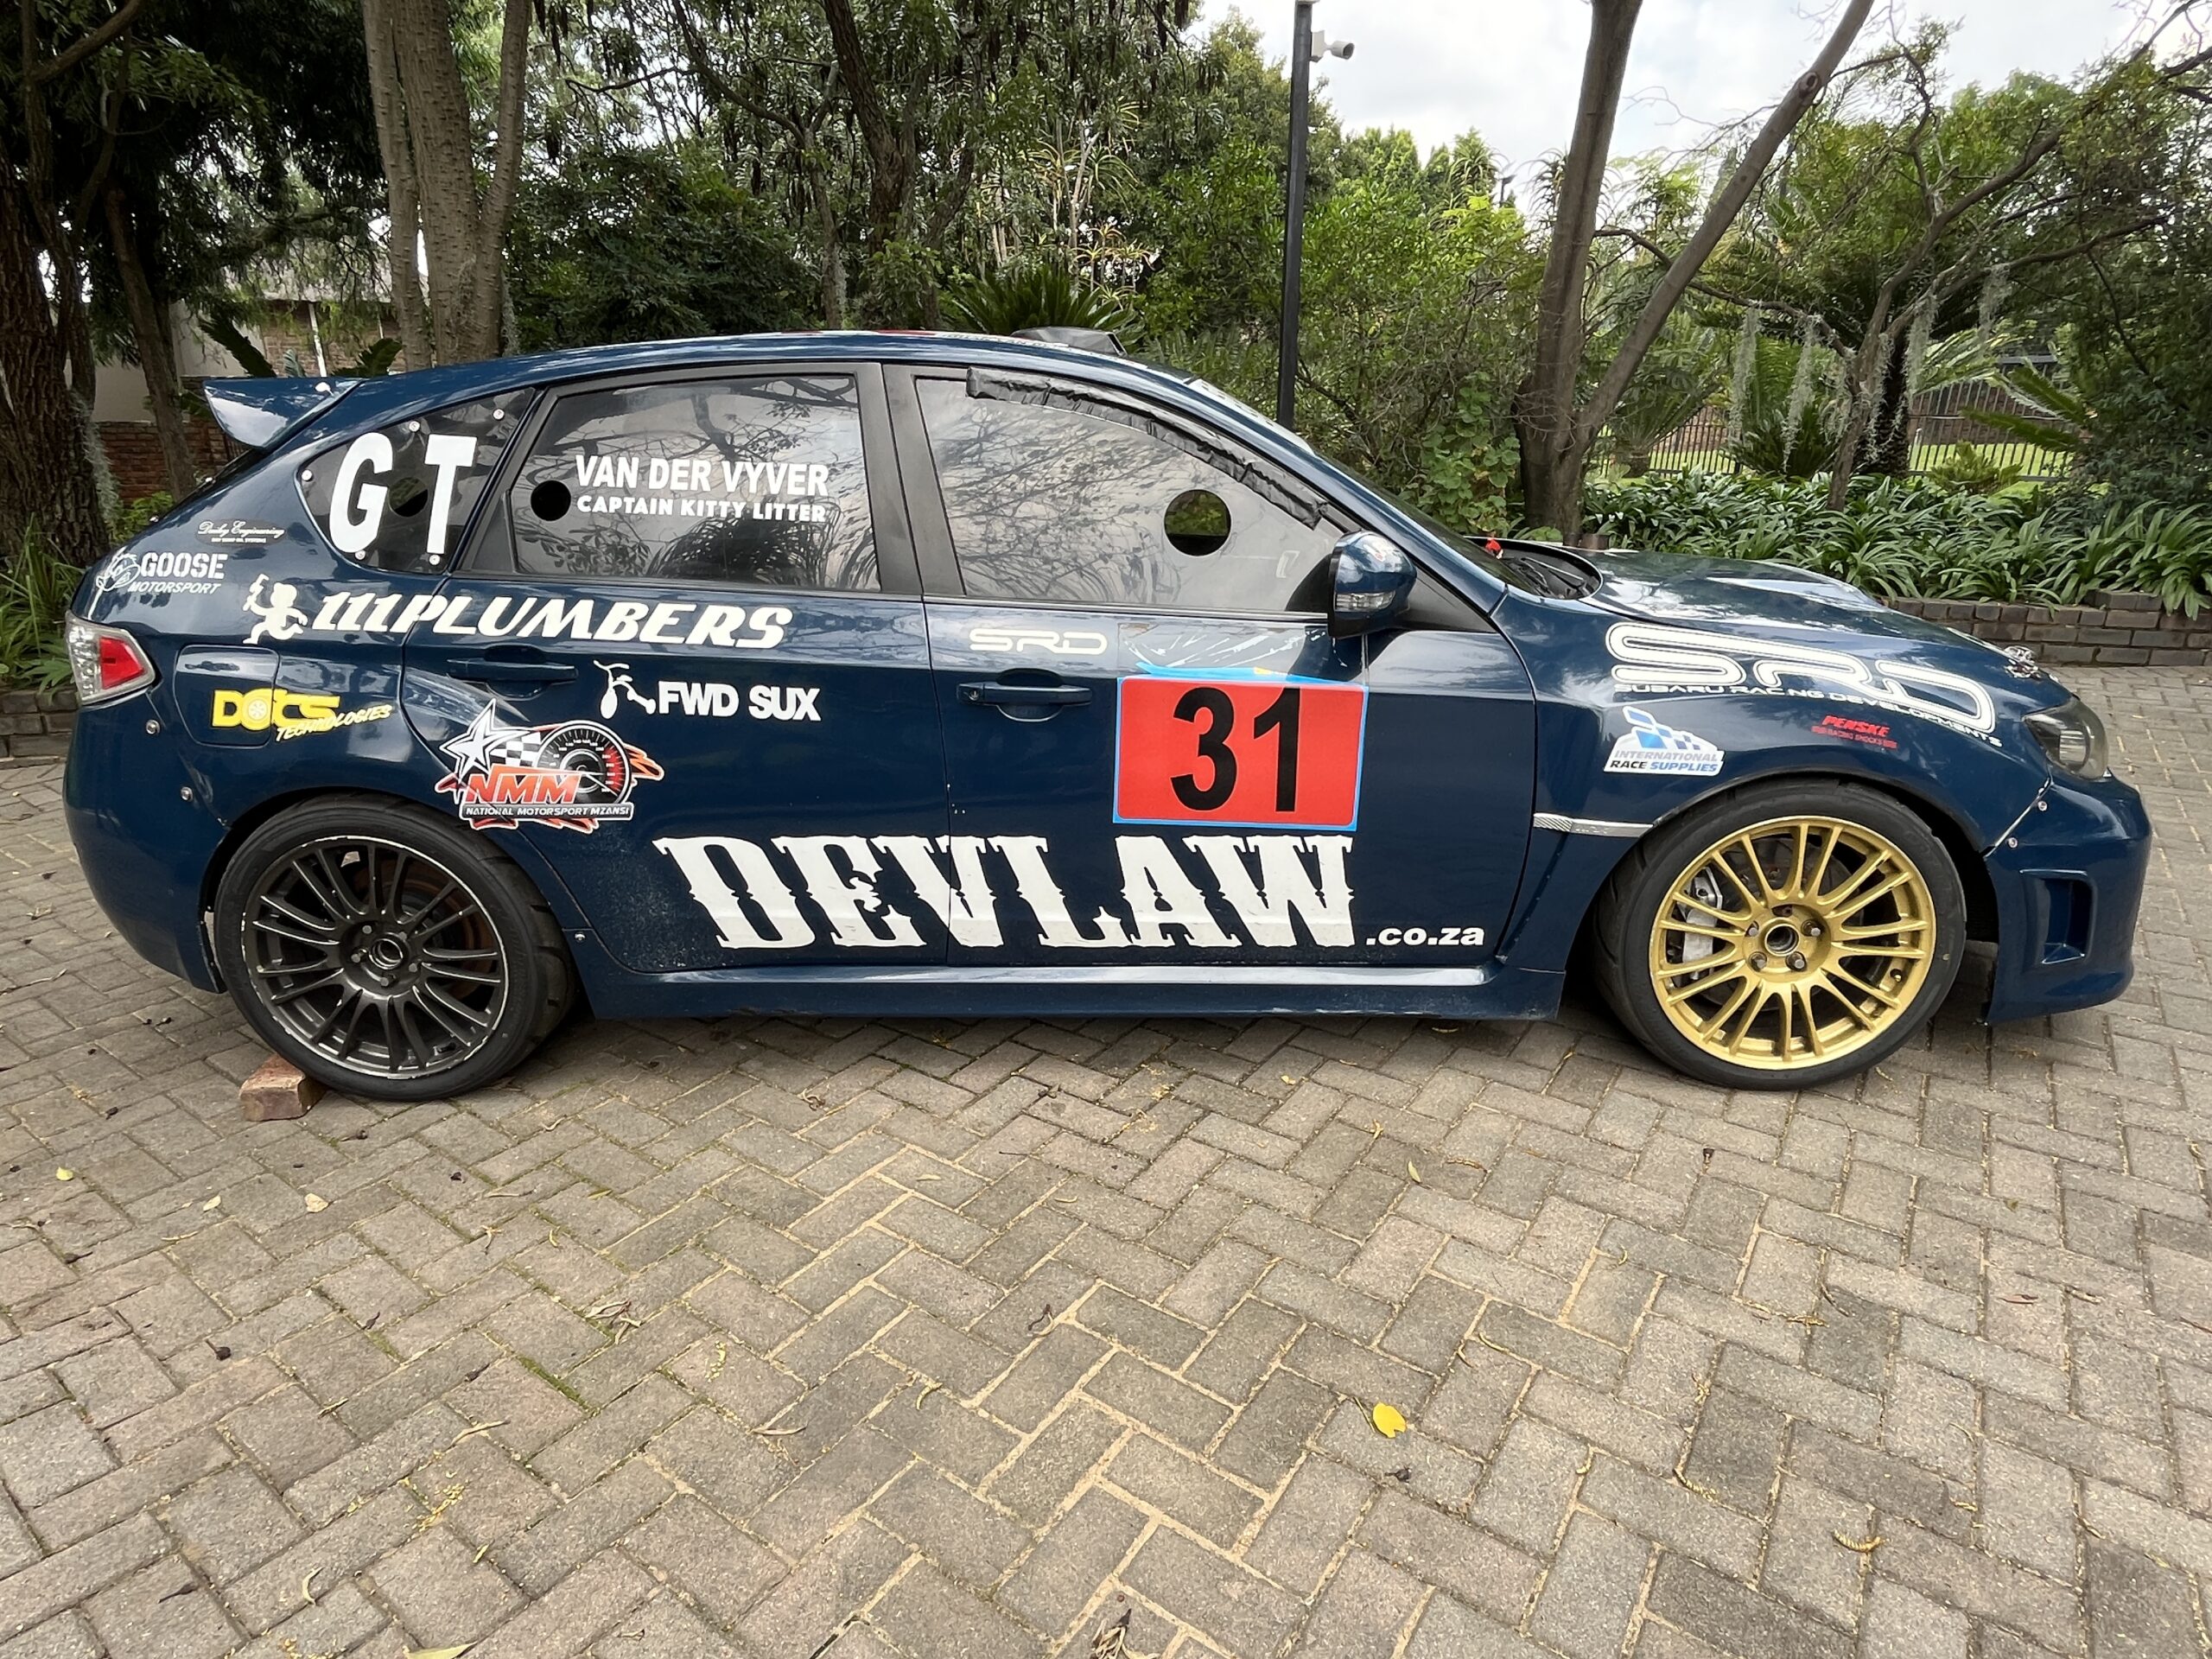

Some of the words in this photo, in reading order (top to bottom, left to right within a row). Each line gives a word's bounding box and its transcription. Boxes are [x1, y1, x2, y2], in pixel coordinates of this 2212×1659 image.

[575, 454, 639, 488] VAN
[649, 458, 711, 492] DER
[721, 461, 829, 496] VYVER
[576, 495, 673, 516] CAPTAIN
[680, 499, 747, 518] KITTY
[753, 503, 825, 523] LITTER
[140, 552, 228, 580] GOOSE
[128, 582, 222, 594] MOTORSPORT
[969, 628, 1107, 655] SRD
[1605, 621, 1996, 734] SRD
[1614, 684, 1725, 694] SUBARU
[1729, 686, 1825, 699] RACNG
[658, 680, 740, 717] FWD
[748, 685, 822, 721] SUX
[276, 704, 393, 741] TECHNOLOGIES
[1821, 715, 1890, 737] PENSKE
[1170, 686, 1300, 812] 31
[1614, 750, 1718, 762] INTERNATIONAL
[1610, 760, 1648, 769] RACE
[1649, 761, 1718, 772] SUPPLIES
[465, 766, 583, 804] NMM
[466, 807, 514, 816] NATIONAL
[517, 807, 589, 816] MOTORSPORT
[590, 807, 630, 816] MZANSI
